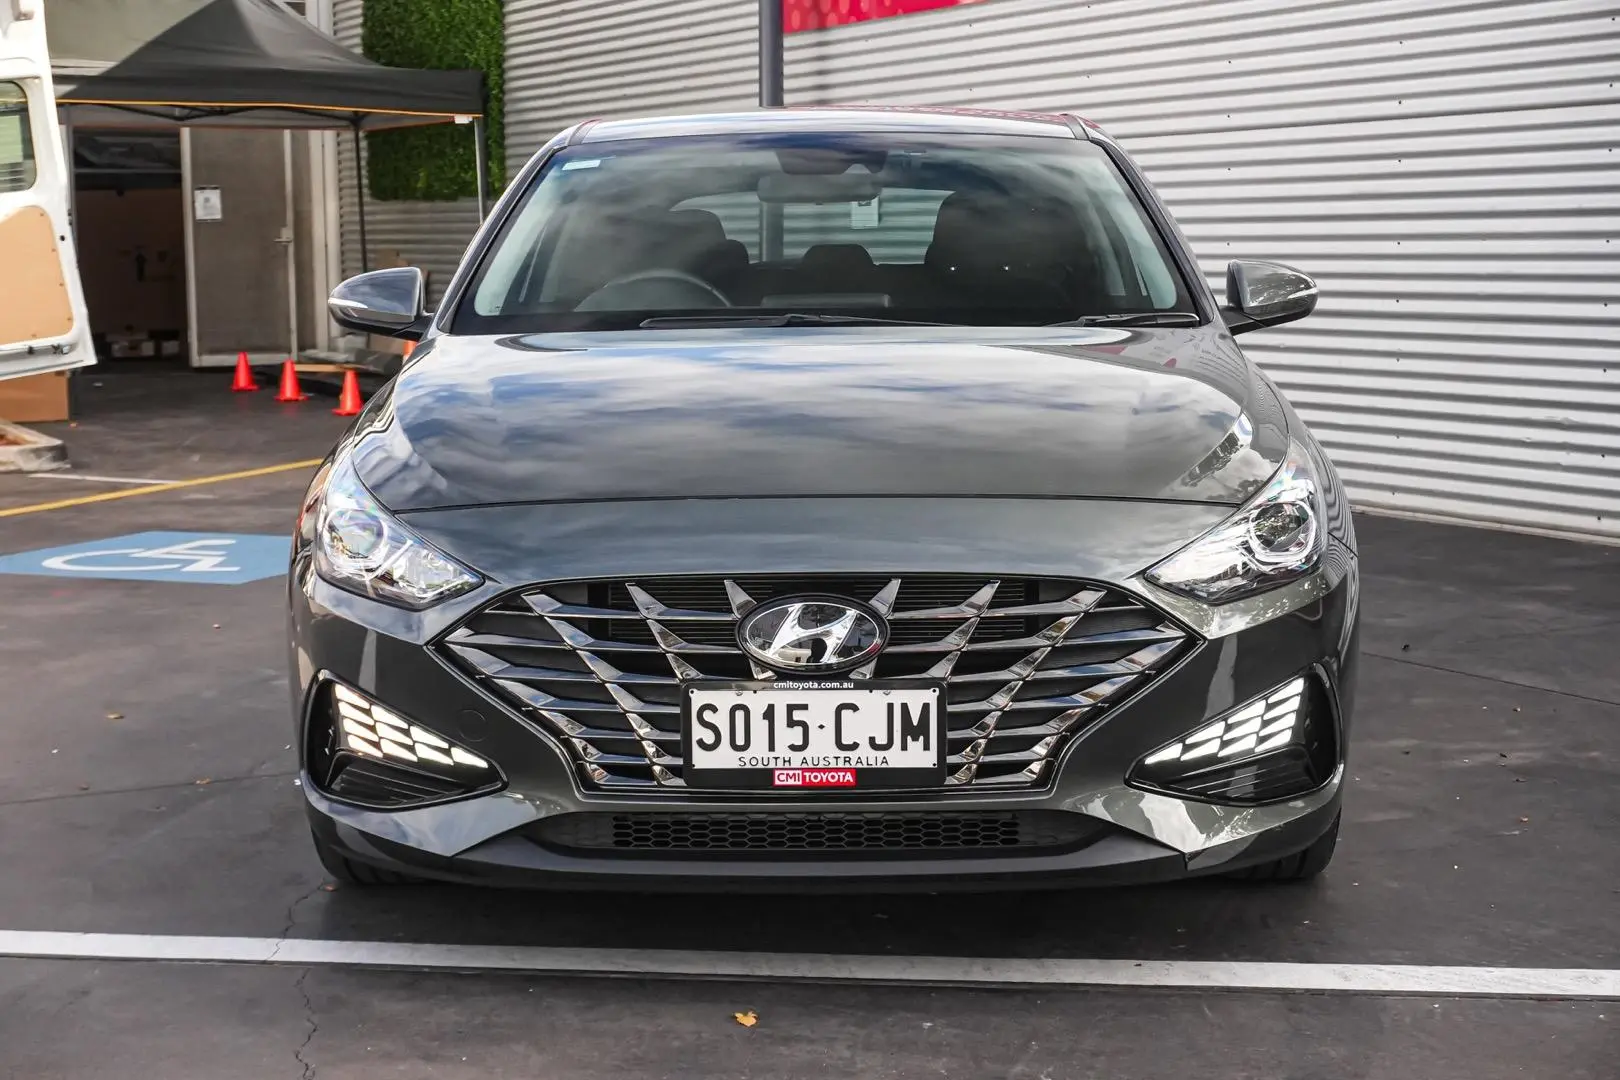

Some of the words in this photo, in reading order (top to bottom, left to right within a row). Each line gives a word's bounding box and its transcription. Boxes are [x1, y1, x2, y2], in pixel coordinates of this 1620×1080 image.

[773, 681, 854, 690] cmitoyota.com.au
[738, 756, 792, 767] SOUTH
[799, 756, 889, 767] AUSTRALIA
[776, 772, 801, 783] CMI
[803, 771, 854, 783] TOYOTA
